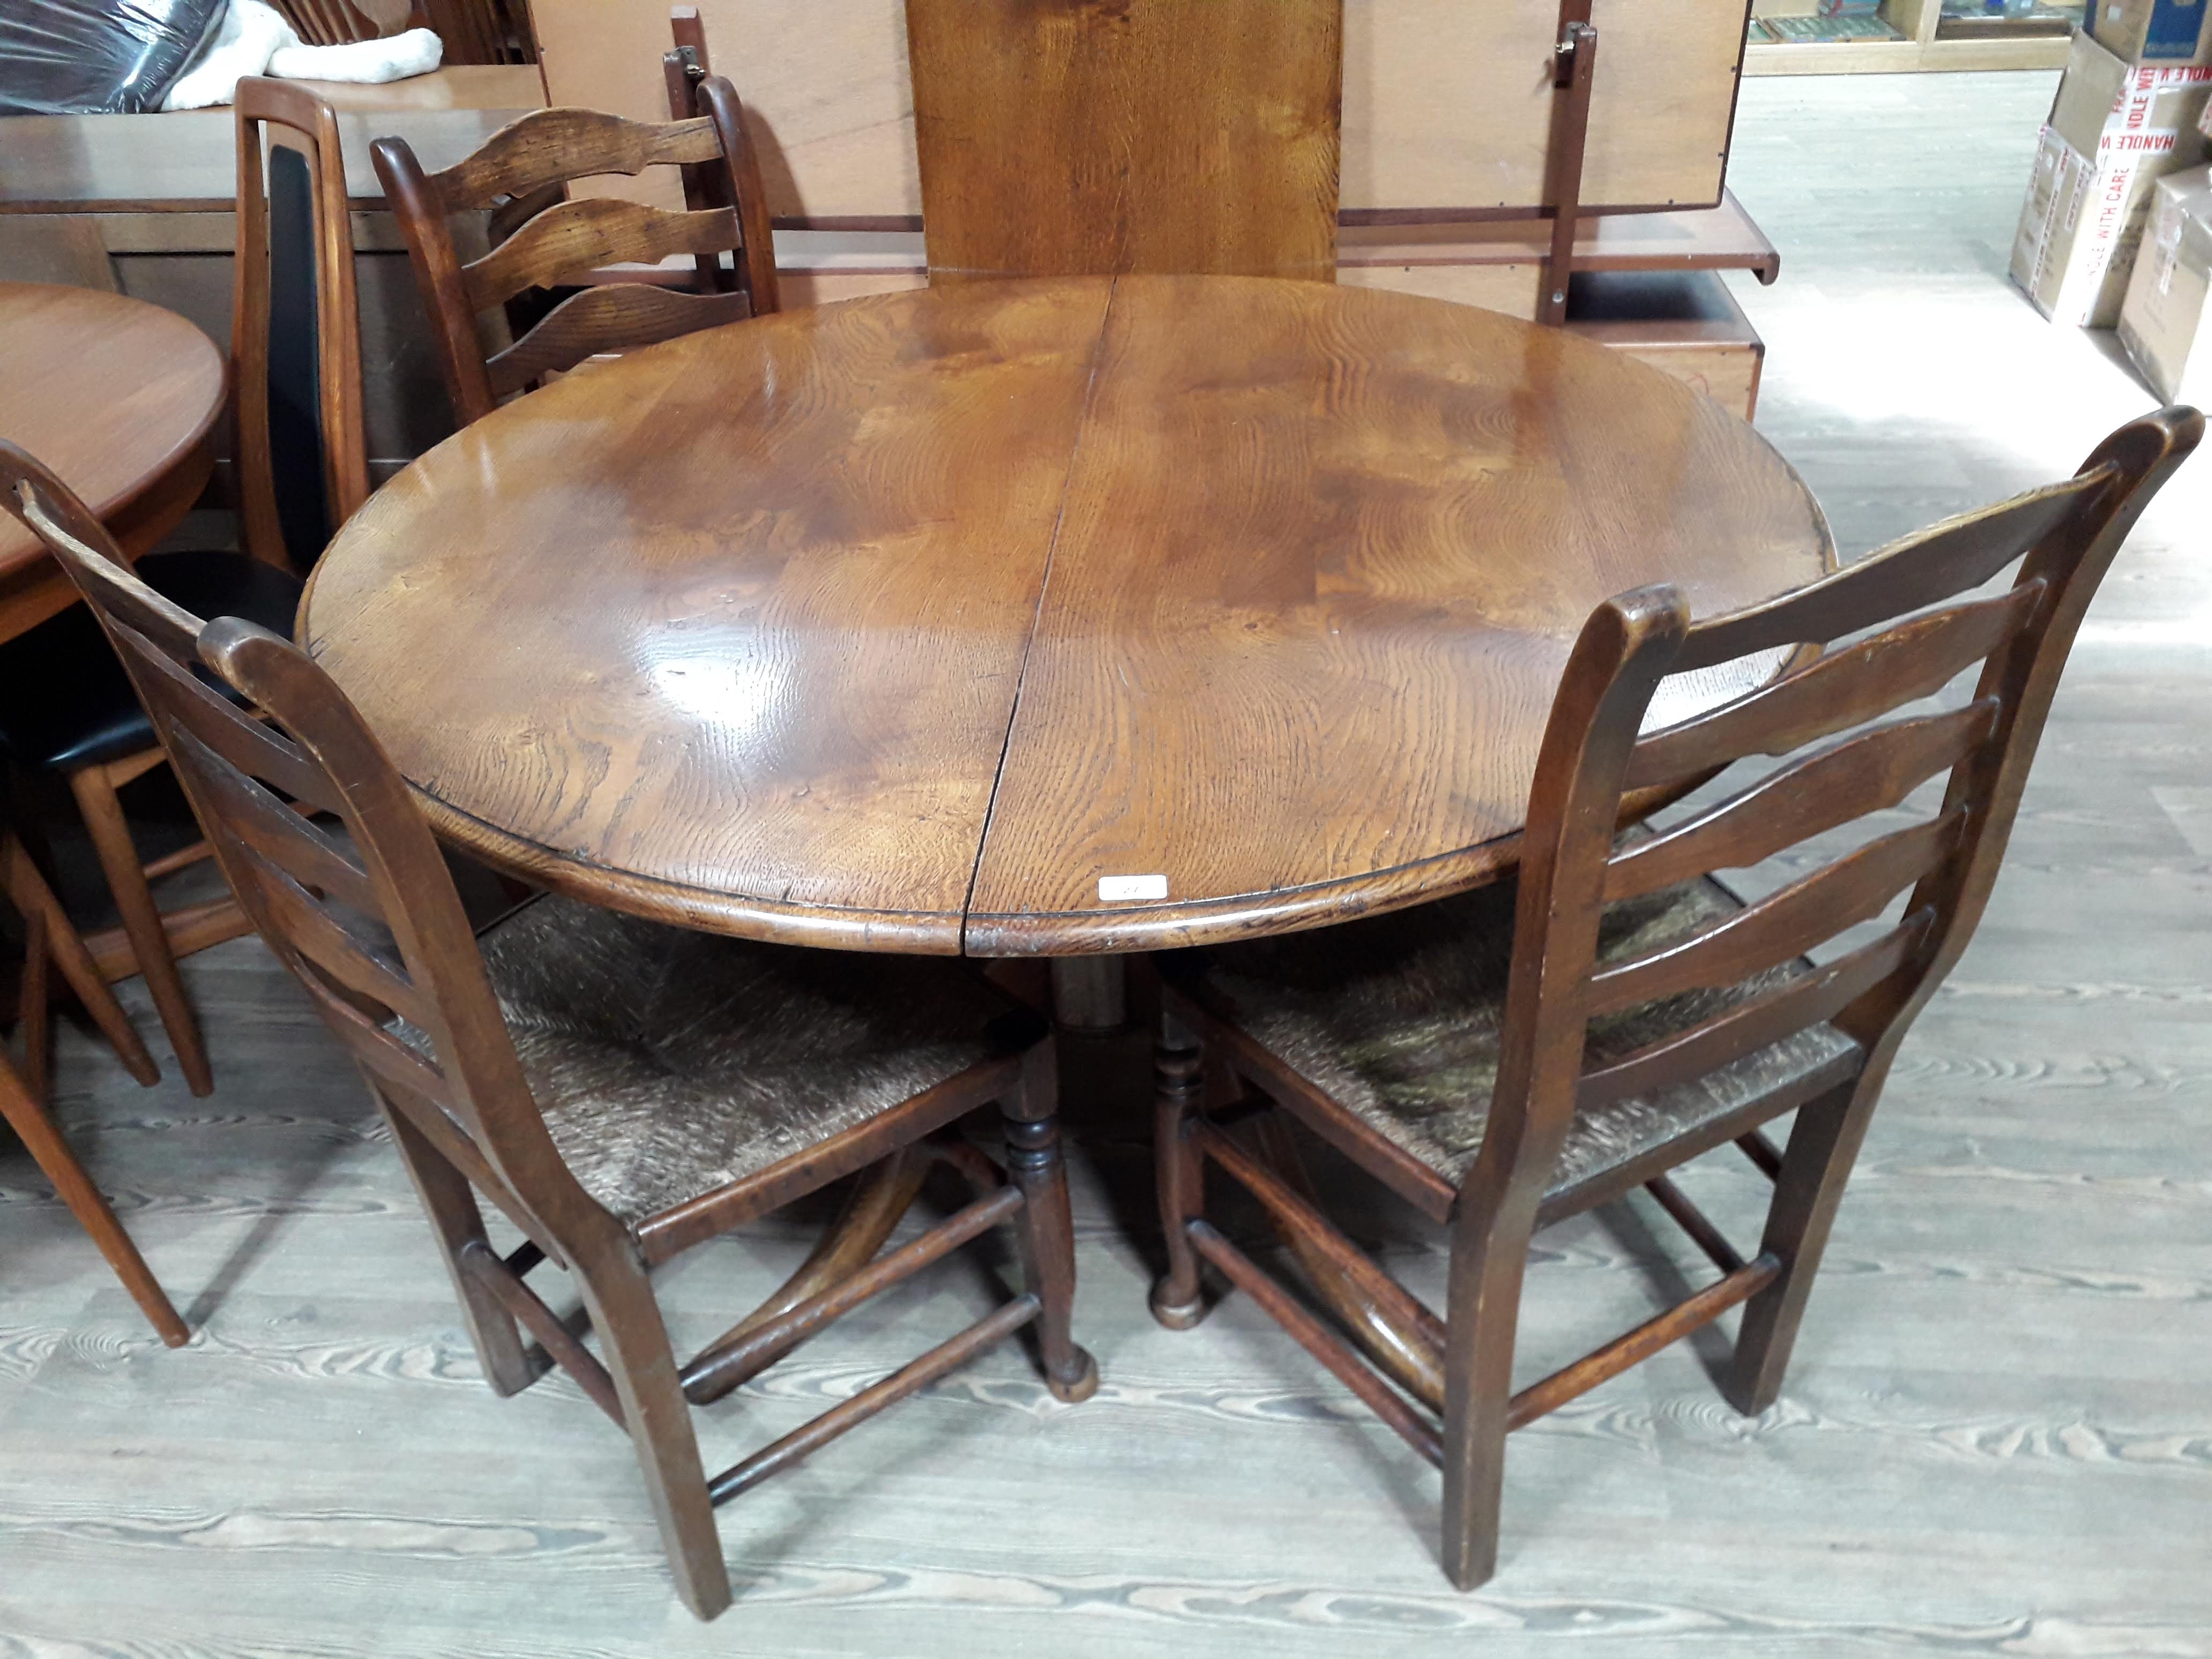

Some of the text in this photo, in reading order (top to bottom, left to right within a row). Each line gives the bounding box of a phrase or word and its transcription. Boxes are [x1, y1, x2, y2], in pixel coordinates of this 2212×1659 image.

[2117, 134, 2176, 151] HANDLE
[2106, 167, 2130, 201] CARE
[2097, 207, 2117, 238] WITH
